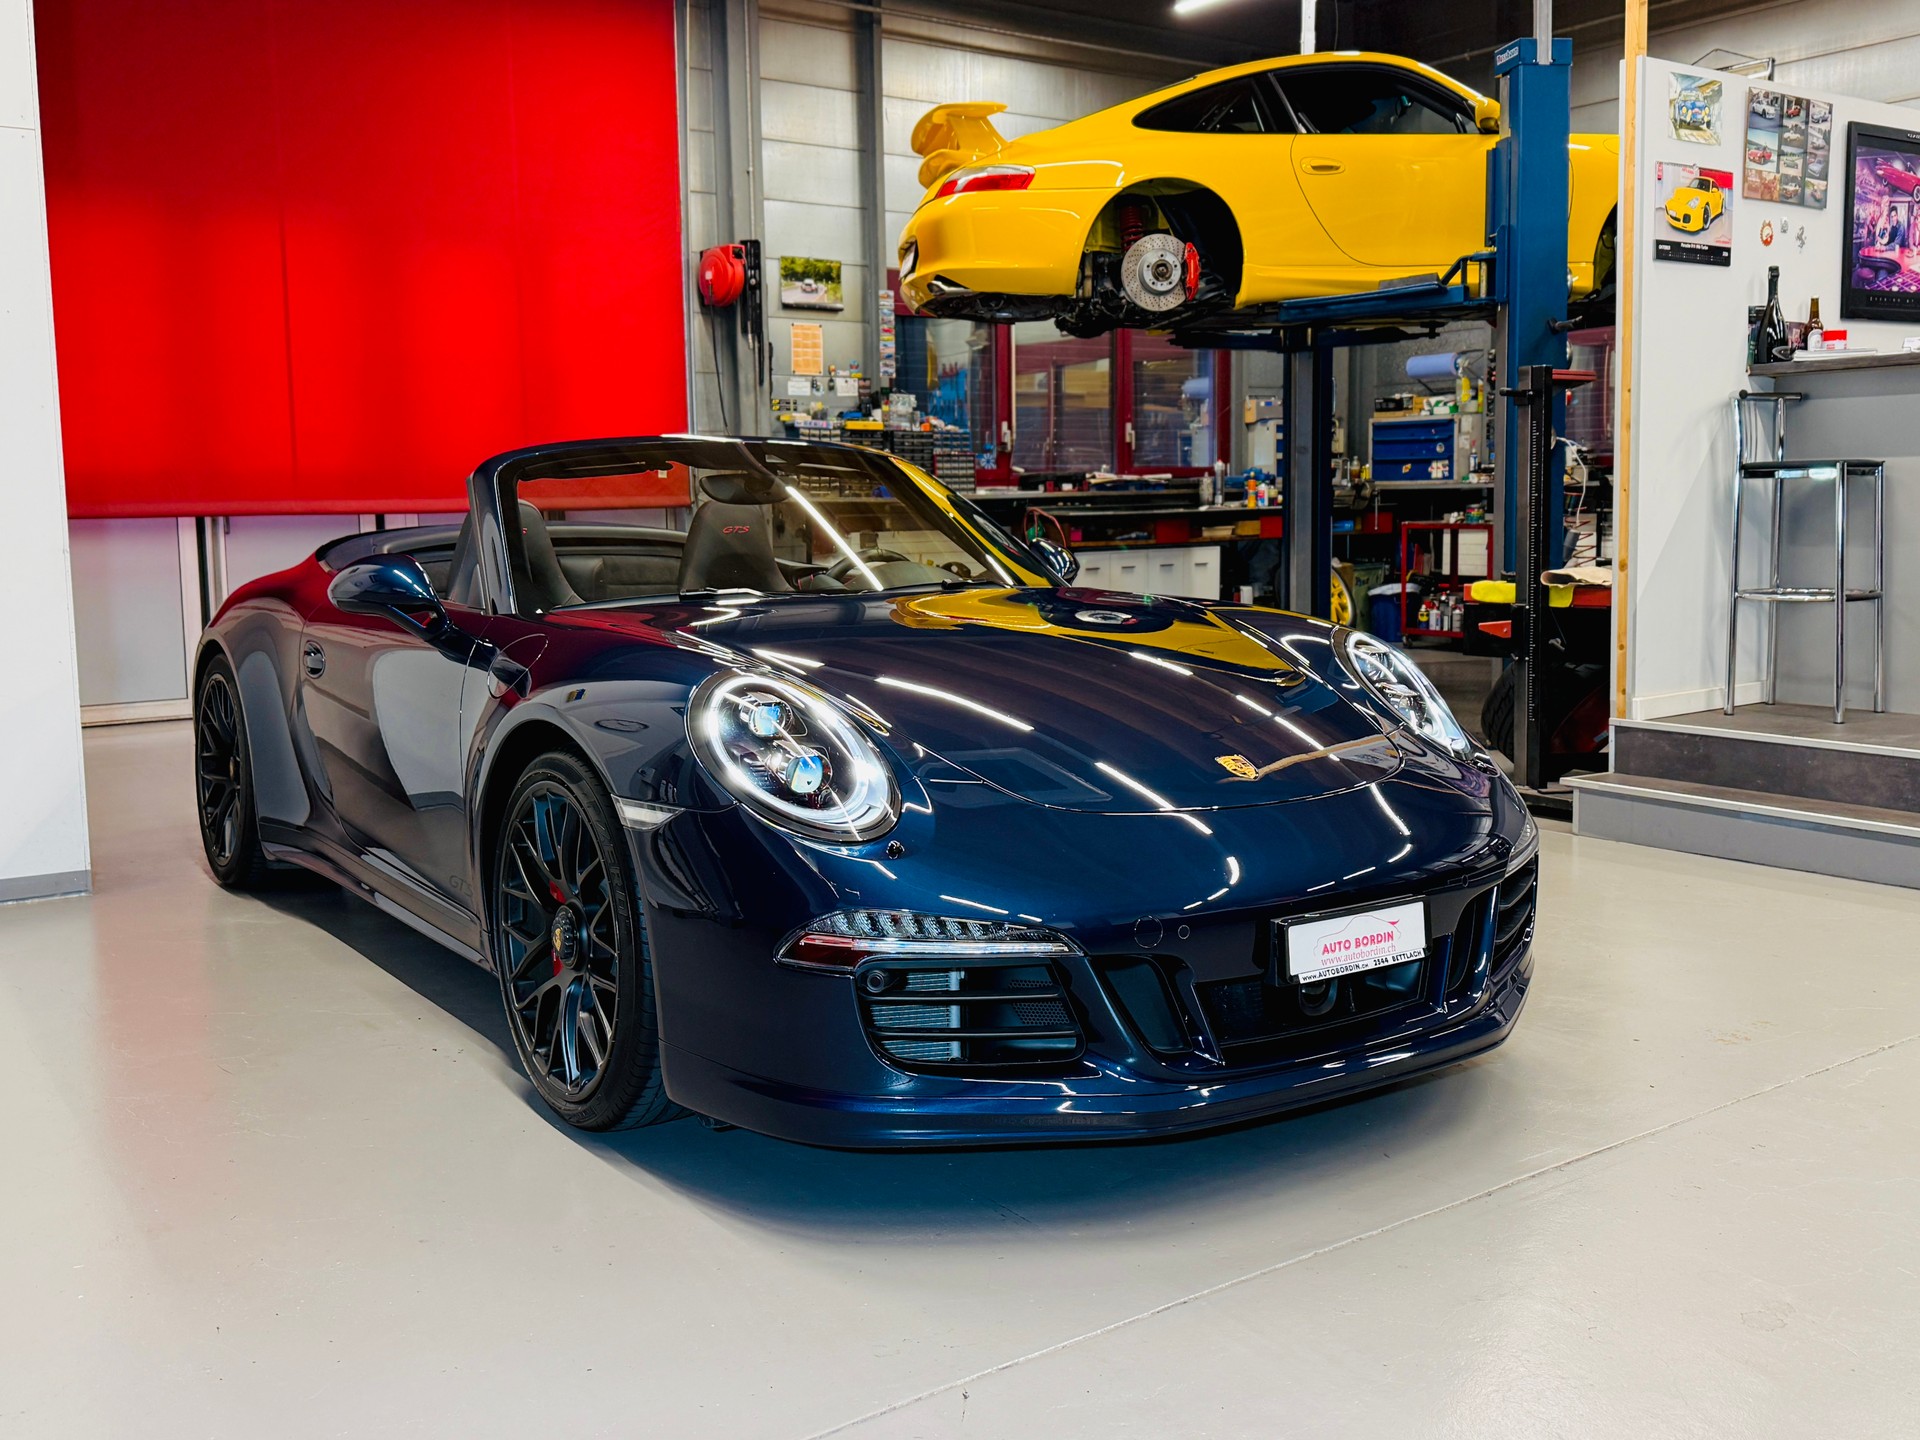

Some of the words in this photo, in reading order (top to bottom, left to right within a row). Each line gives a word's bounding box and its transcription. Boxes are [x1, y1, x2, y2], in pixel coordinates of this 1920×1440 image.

[722, 525, 750, 534] GTS
[449, 875, 473, 897] GTS
[1321, 939, 1352, 956] AUTO
[1355, 930, 1394, 949] BORDIN
[1320, 943, 1397, 967] www.autobordin.ch
[1373, 956, 1389, 967] 2544
[1392, 950, 1422, 963] BETTLACH
